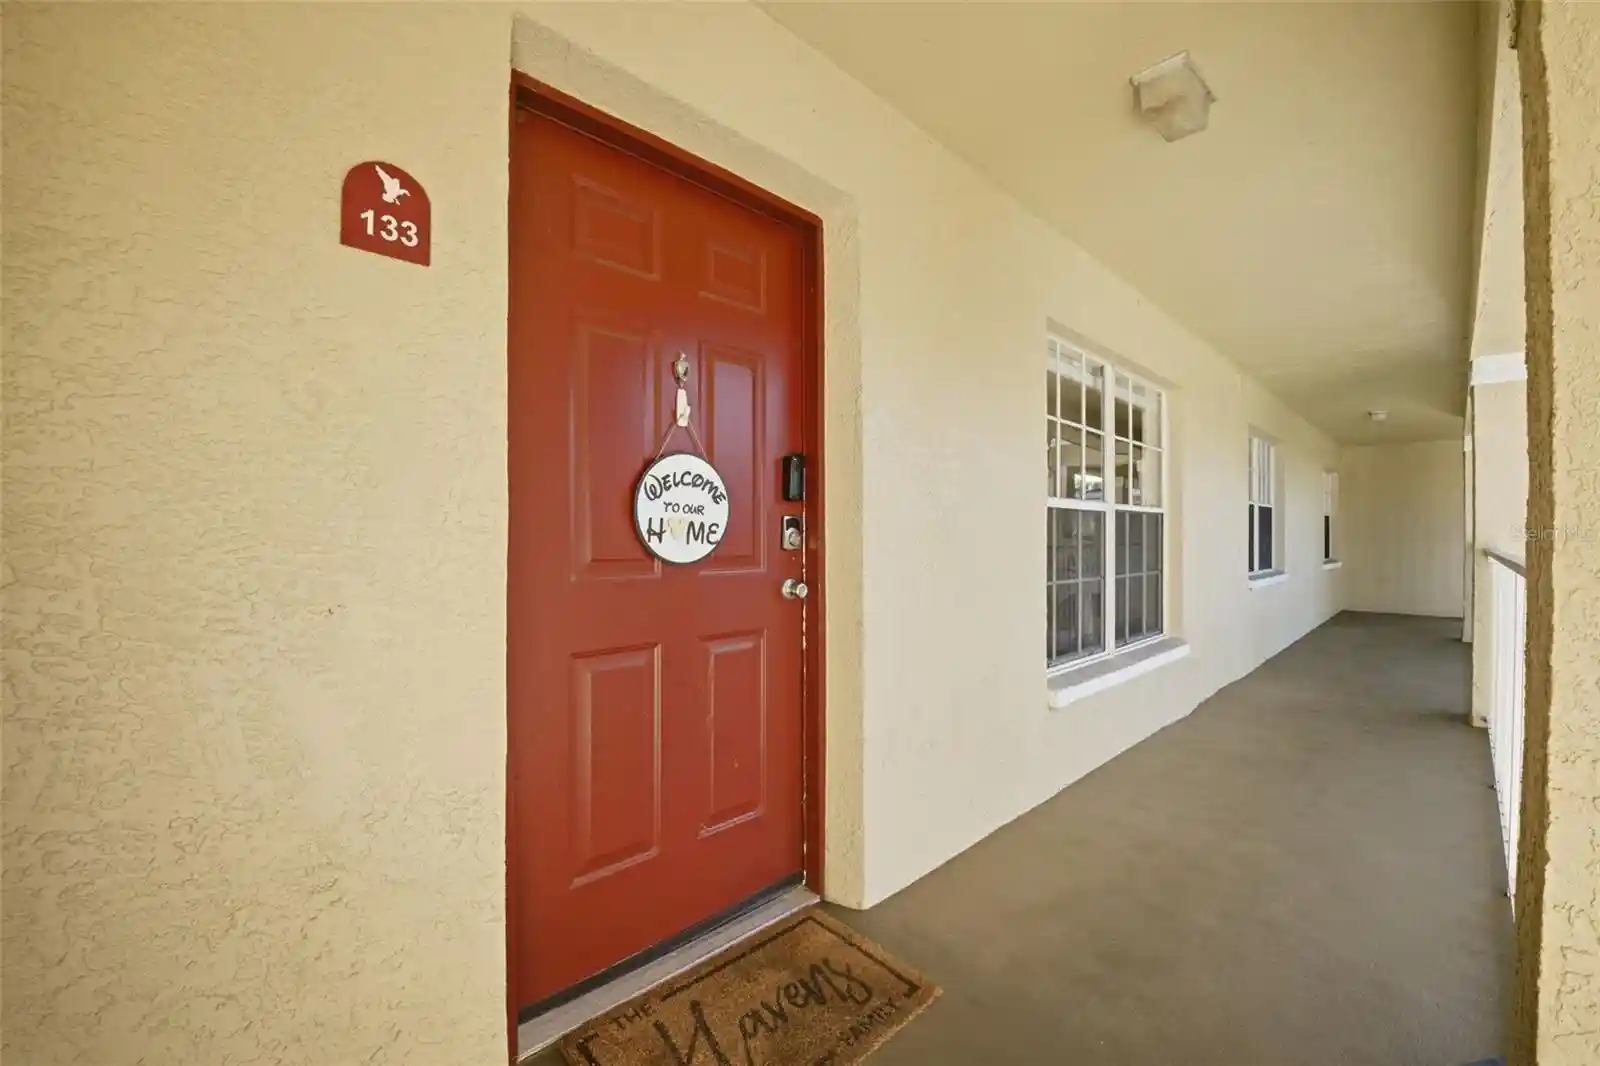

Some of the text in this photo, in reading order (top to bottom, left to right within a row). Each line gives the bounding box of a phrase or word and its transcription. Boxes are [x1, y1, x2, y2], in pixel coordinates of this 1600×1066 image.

[360, 209, 419, 247] 133
[644, 471, 727, 505] WELCOME
[663, 501, 705, 516] TO OUR
[646, 517, 720, 545] HME
[614, 1003, 651, 1030] THE
